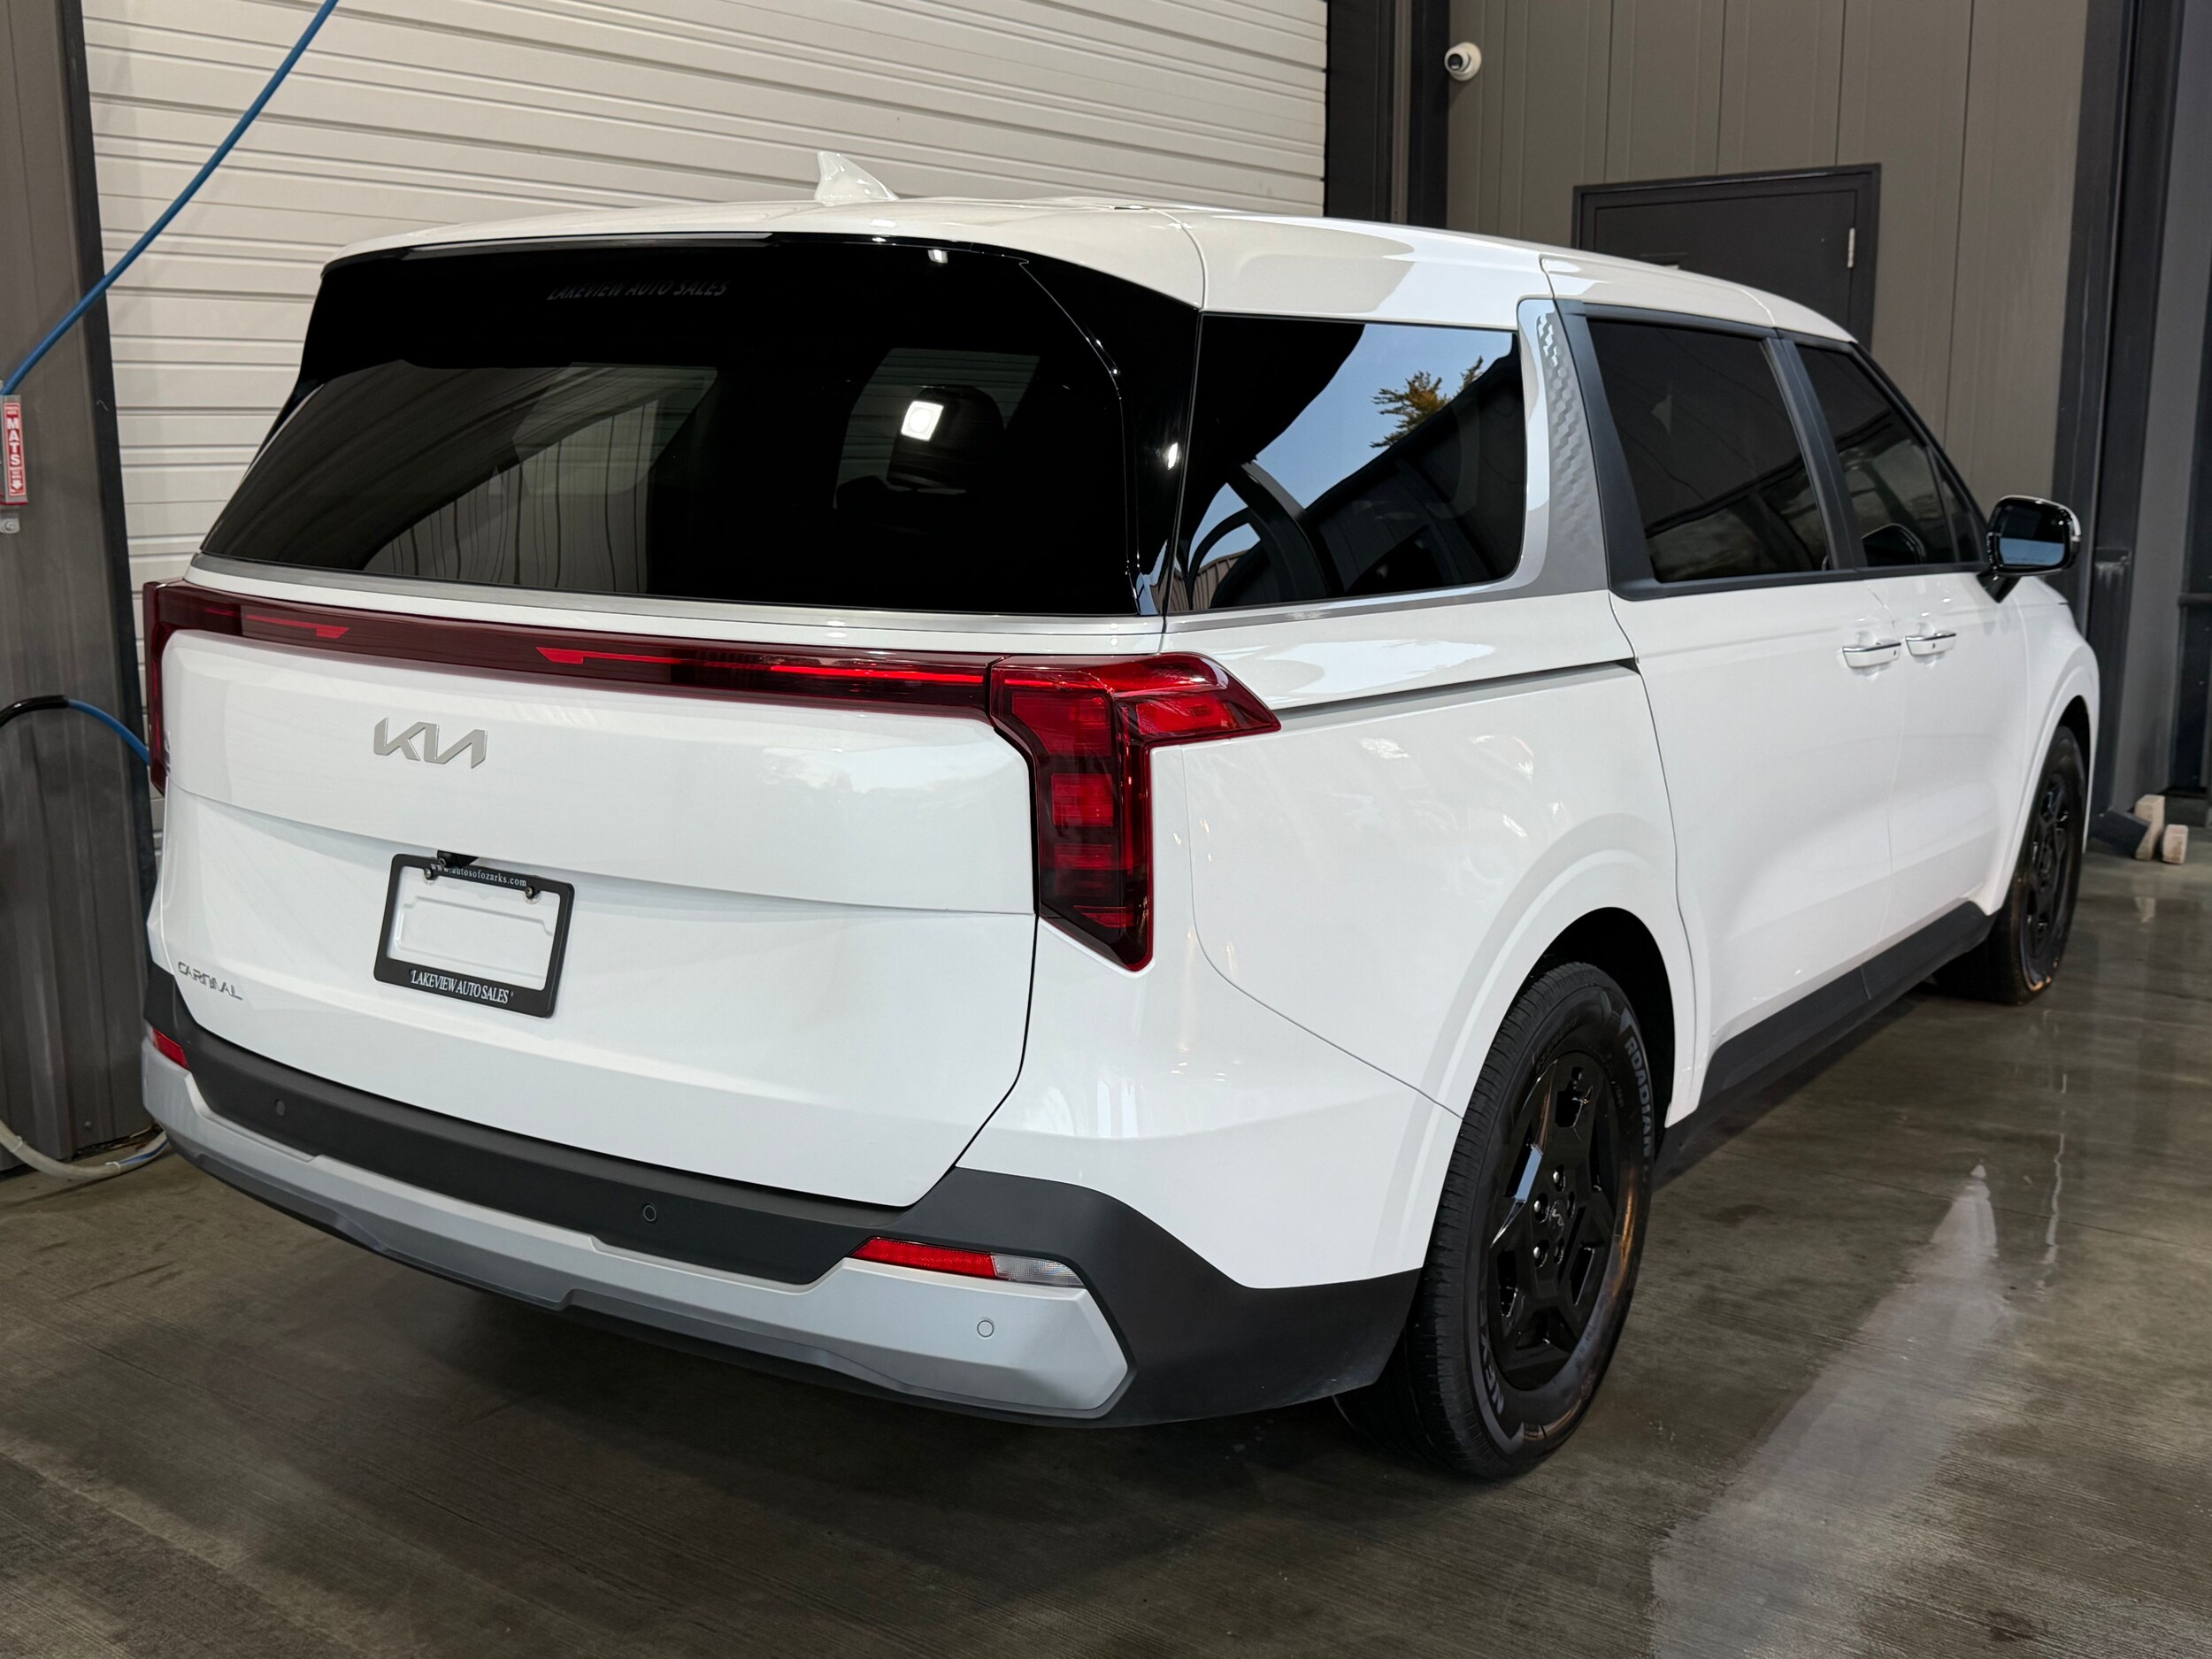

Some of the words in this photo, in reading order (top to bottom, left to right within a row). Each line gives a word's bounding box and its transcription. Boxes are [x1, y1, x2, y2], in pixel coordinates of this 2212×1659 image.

[547, 281, 626, 300] LAKEVIEW
[625, 280, 674, 296] AUTO
[673, 279, 731, 296] SALES
[6, 418, 21, 466] MATS
[373, 717, 488, 769] KIA
[431, 863, 527, 887] www.autosofozarks.com
[411, 970, 457, 992] LAKEVIEW
[456, 980, 481, 998] AUTO
[480, 986, 510, 1004] SALES
[1624, 1036, 1652, 1157] ROADIAN
